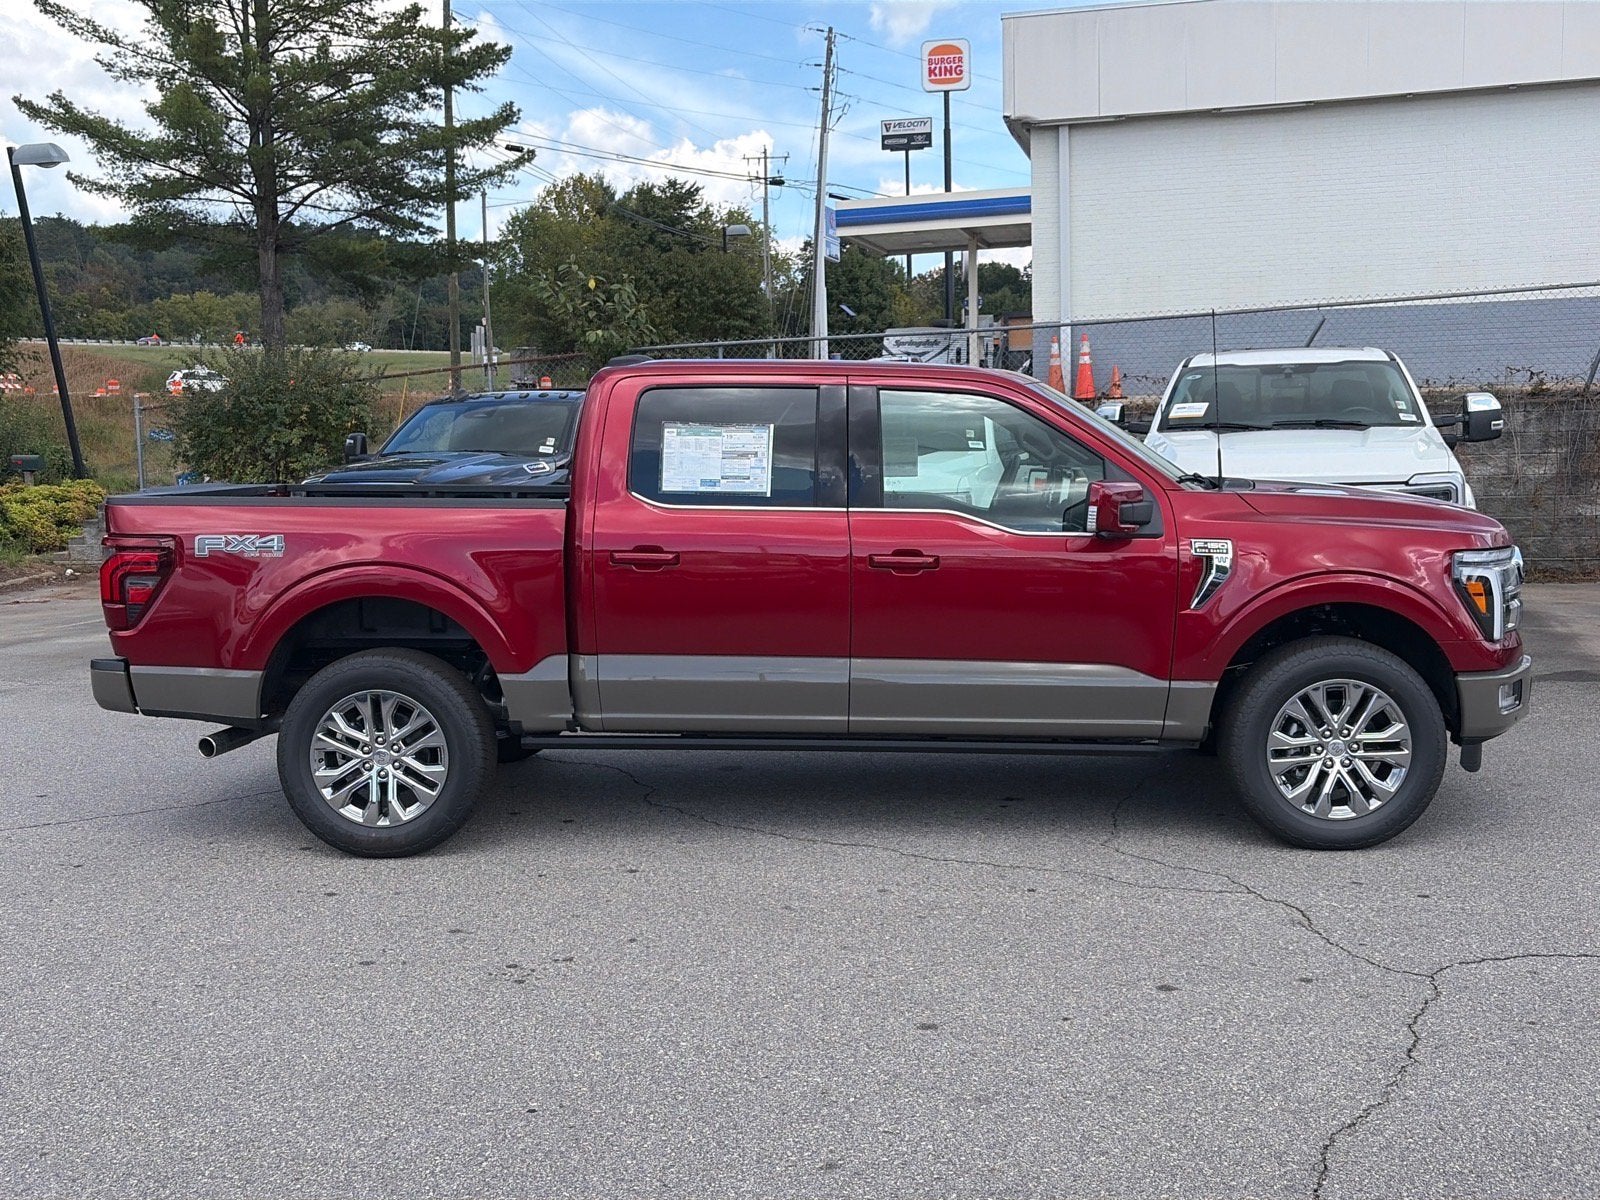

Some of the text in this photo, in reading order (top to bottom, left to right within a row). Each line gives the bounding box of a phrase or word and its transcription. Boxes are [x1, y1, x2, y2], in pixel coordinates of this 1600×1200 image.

[928, 56, 963, 65] BURGER
[928, 65, 964, 78] KING
[892, 120, 929, 129] VELOCITY
[893, 339, 941, 348] Springdale
[195, 535, 285, 557] FX4
